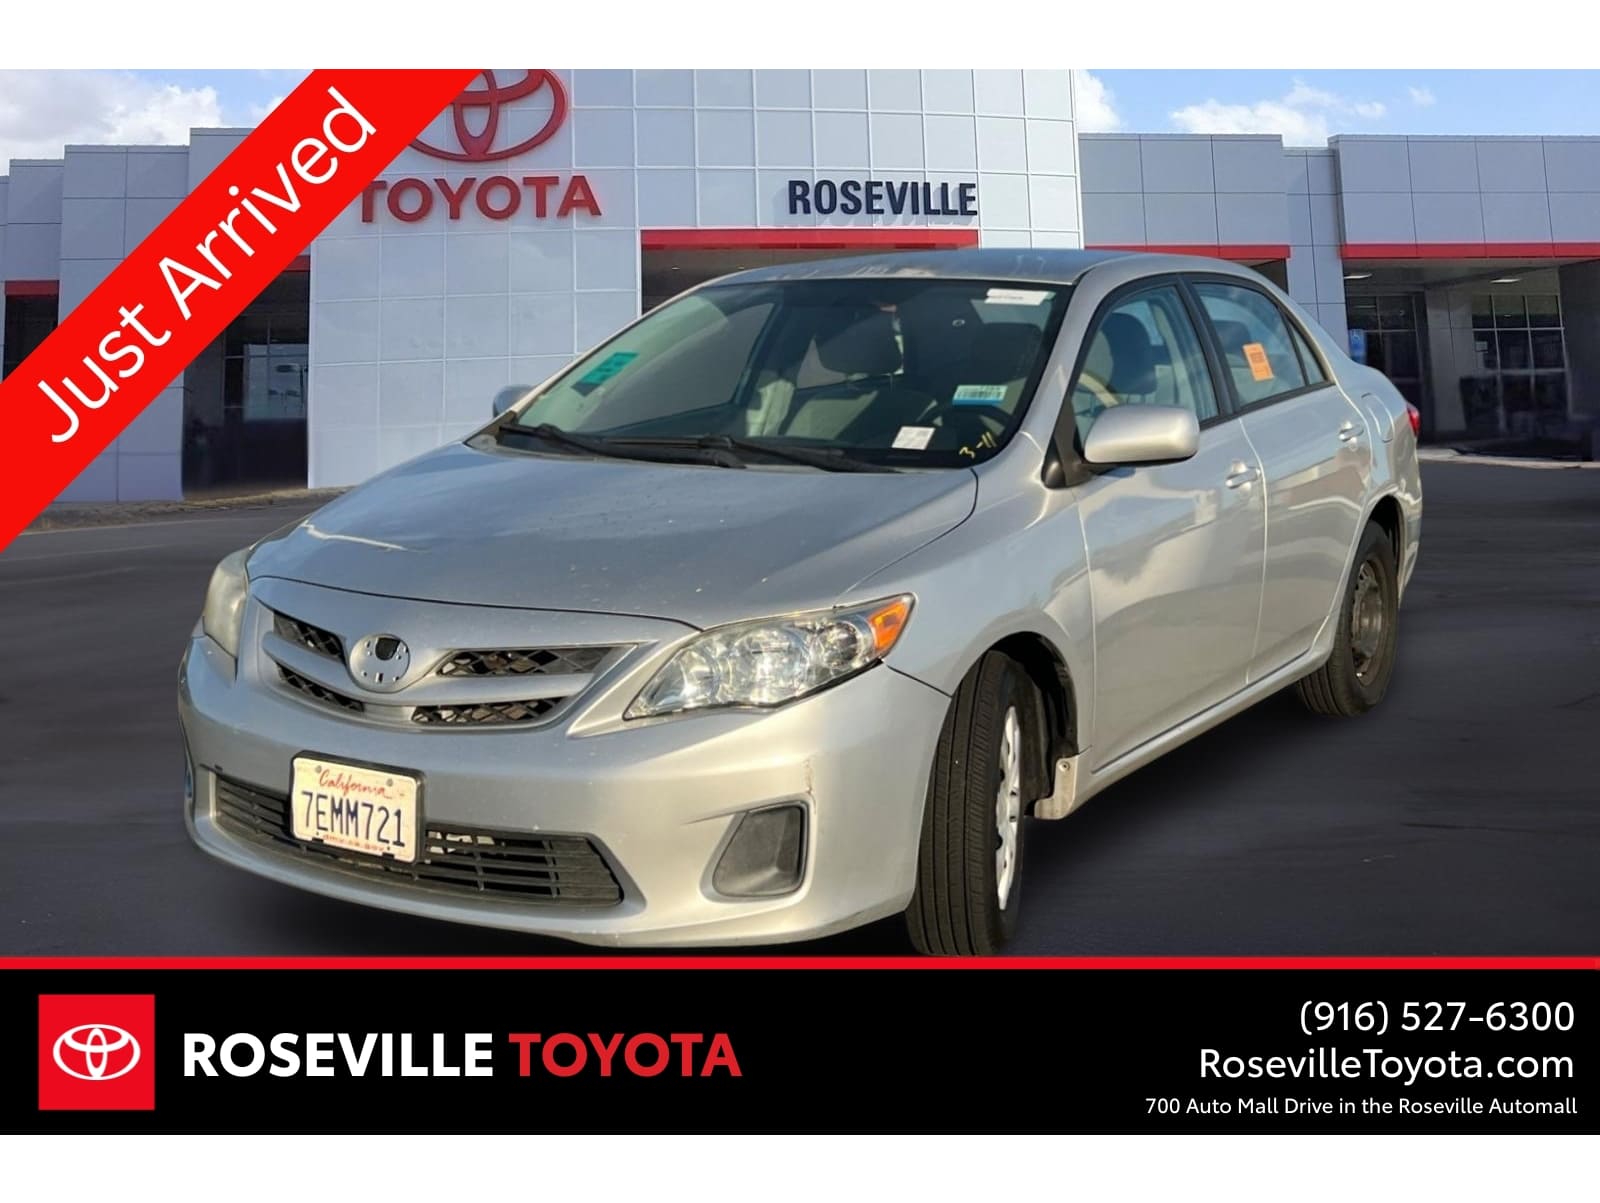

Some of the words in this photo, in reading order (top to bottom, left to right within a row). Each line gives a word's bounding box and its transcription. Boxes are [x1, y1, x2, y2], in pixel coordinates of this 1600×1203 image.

[361, 175, 603, 224] TOYOTA
[788, 180, 979, 216] ROSEVILLE
[318, 768, 393, 800] California
[301, 790, 406, 848] 7EMM721
